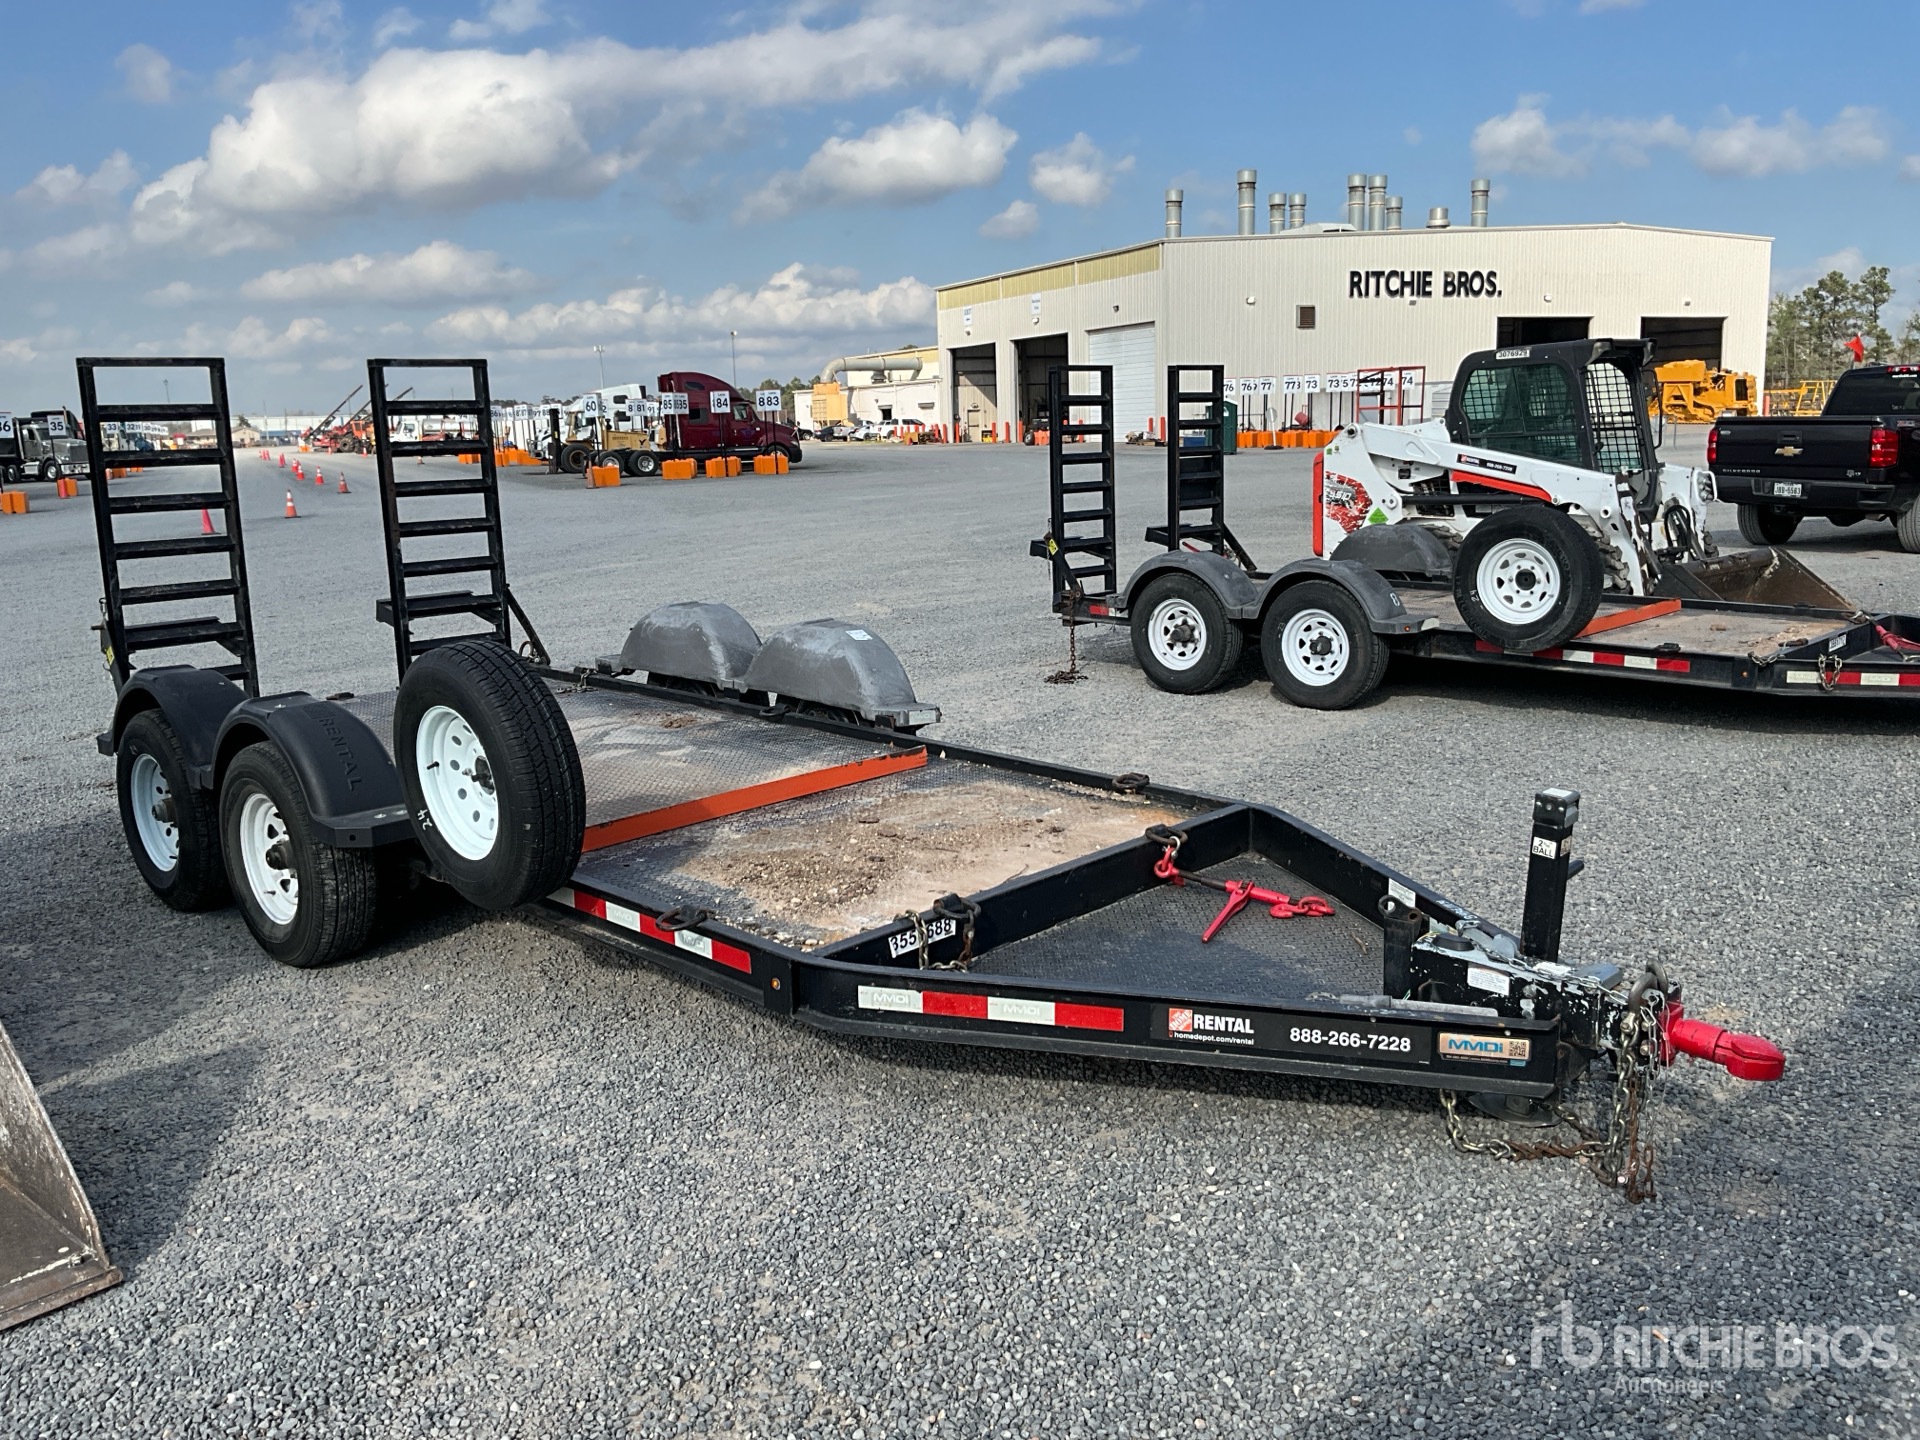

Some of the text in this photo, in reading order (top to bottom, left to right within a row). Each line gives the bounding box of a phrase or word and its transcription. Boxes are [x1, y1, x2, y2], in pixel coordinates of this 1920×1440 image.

[1349, 270, 1502, 298] RITCHIE BROS.
[1241, 382, 1252, 391] 76
[1261, 382, 1272, 390] 77
[1284, 381, 1296, 389] 77
[1305, 380, 1318, 389] 73
[1328, 379, 1340, 388] 73
[585, 400, 597, 412] 60
[663, 400, 672, 409] 85
[716, 397, 729, 408] 84
[766, 396, 779, 406] 83
[636, 404, 645, 412] 81
[49, 421, 64, 431] 35
[107, 423, 117, 431] 33
[319, 716, 363, 792] RENTAL
[1532, 845, 1554, 858] BALL
[890, 918, 952, 951] 355688
[1193, 1013, 1255, 1034] RENTAL
[1174, 1031, 1254, 1046] homedepot.com/rental
[1289, 1027, 1412, 1052] 888-266-7228
